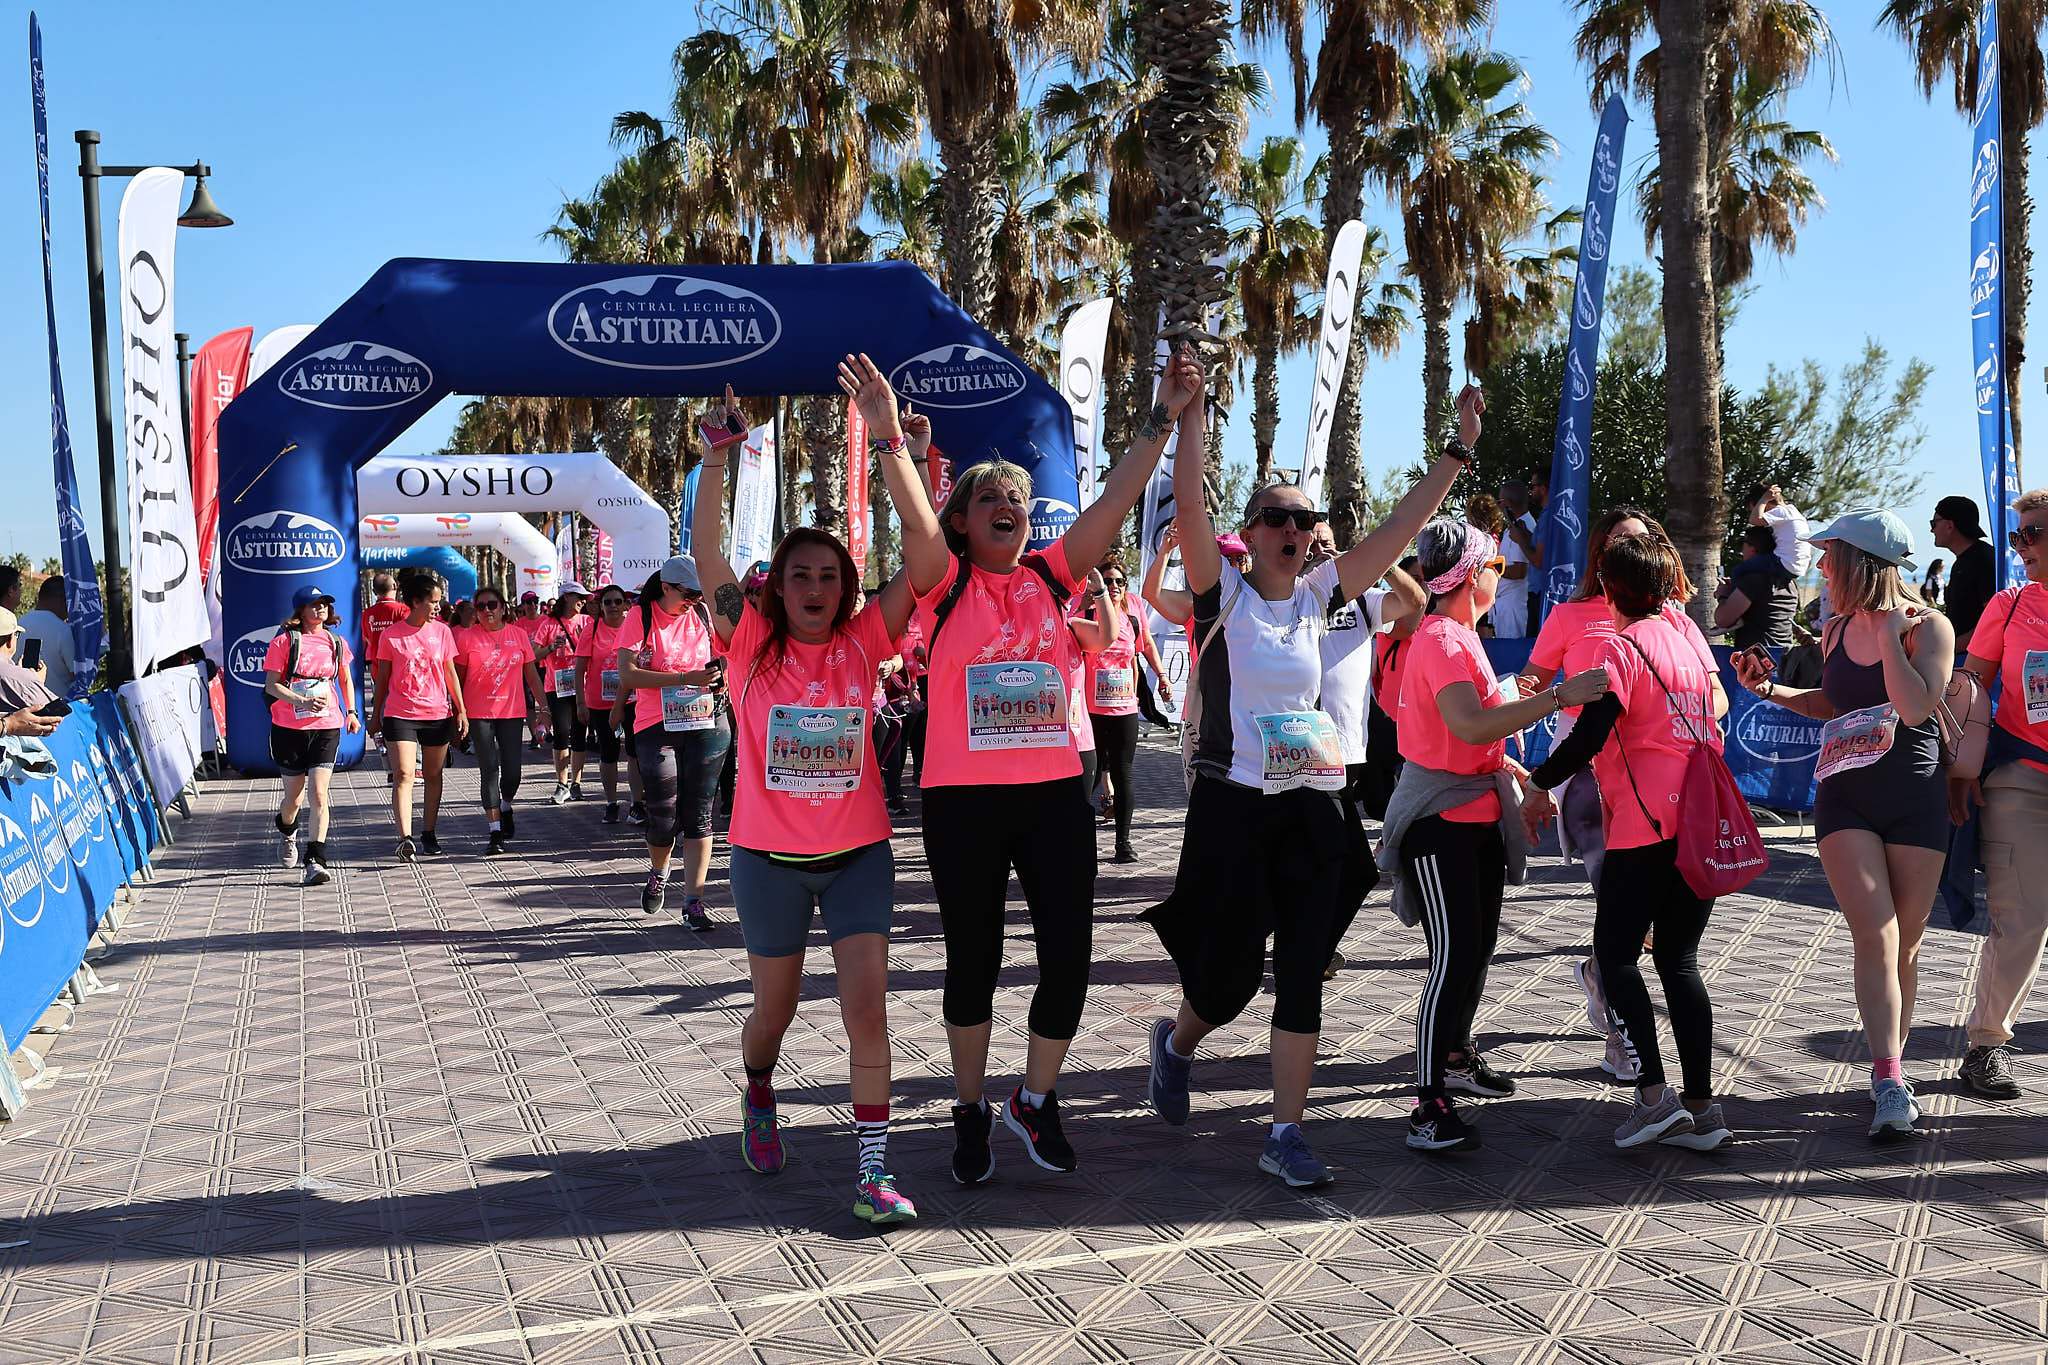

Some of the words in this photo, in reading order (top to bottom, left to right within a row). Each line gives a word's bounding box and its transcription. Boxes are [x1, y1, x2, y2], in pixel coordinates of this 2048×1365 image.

[603, 301, 676, 312] CENTRAL
[684, 302, 756, 312] LECHERA
[567, 302, 765, 344] ASTURIANA
[313, 363, 365, 372] CENTRAL
[369, 364, 419, 373] LECHERA
[920, 365, 967, 375] CENTRAL
[970, 364, 1012, 372] LECHERA
[288, 367, 421, 393] ASTURIANA
[901, 370, 1020, 394] ASTURIANA
[396, 465, 553, 498] OYSHO
[597, 495, 643, 508] OYSHO
[246, 532, 288, 540] CENTRAL
[292, 532, 334, 540] LECHERA
[231, 536, 338, 559] ASTURIANA
[679, 704, 698, 712] 016
[1000, 700, 1037, 715] 016
[974, 727, 998, 735] CARRERA
[1037, 724, 1062, 732] VALENCIA
[1742, 715, 1823, 745] ASTURIANA
[980, 737, 1010, 745] OYSHO
[800, 745, 835, 760] 016
[772, 767, 796, 775] CARRERA
